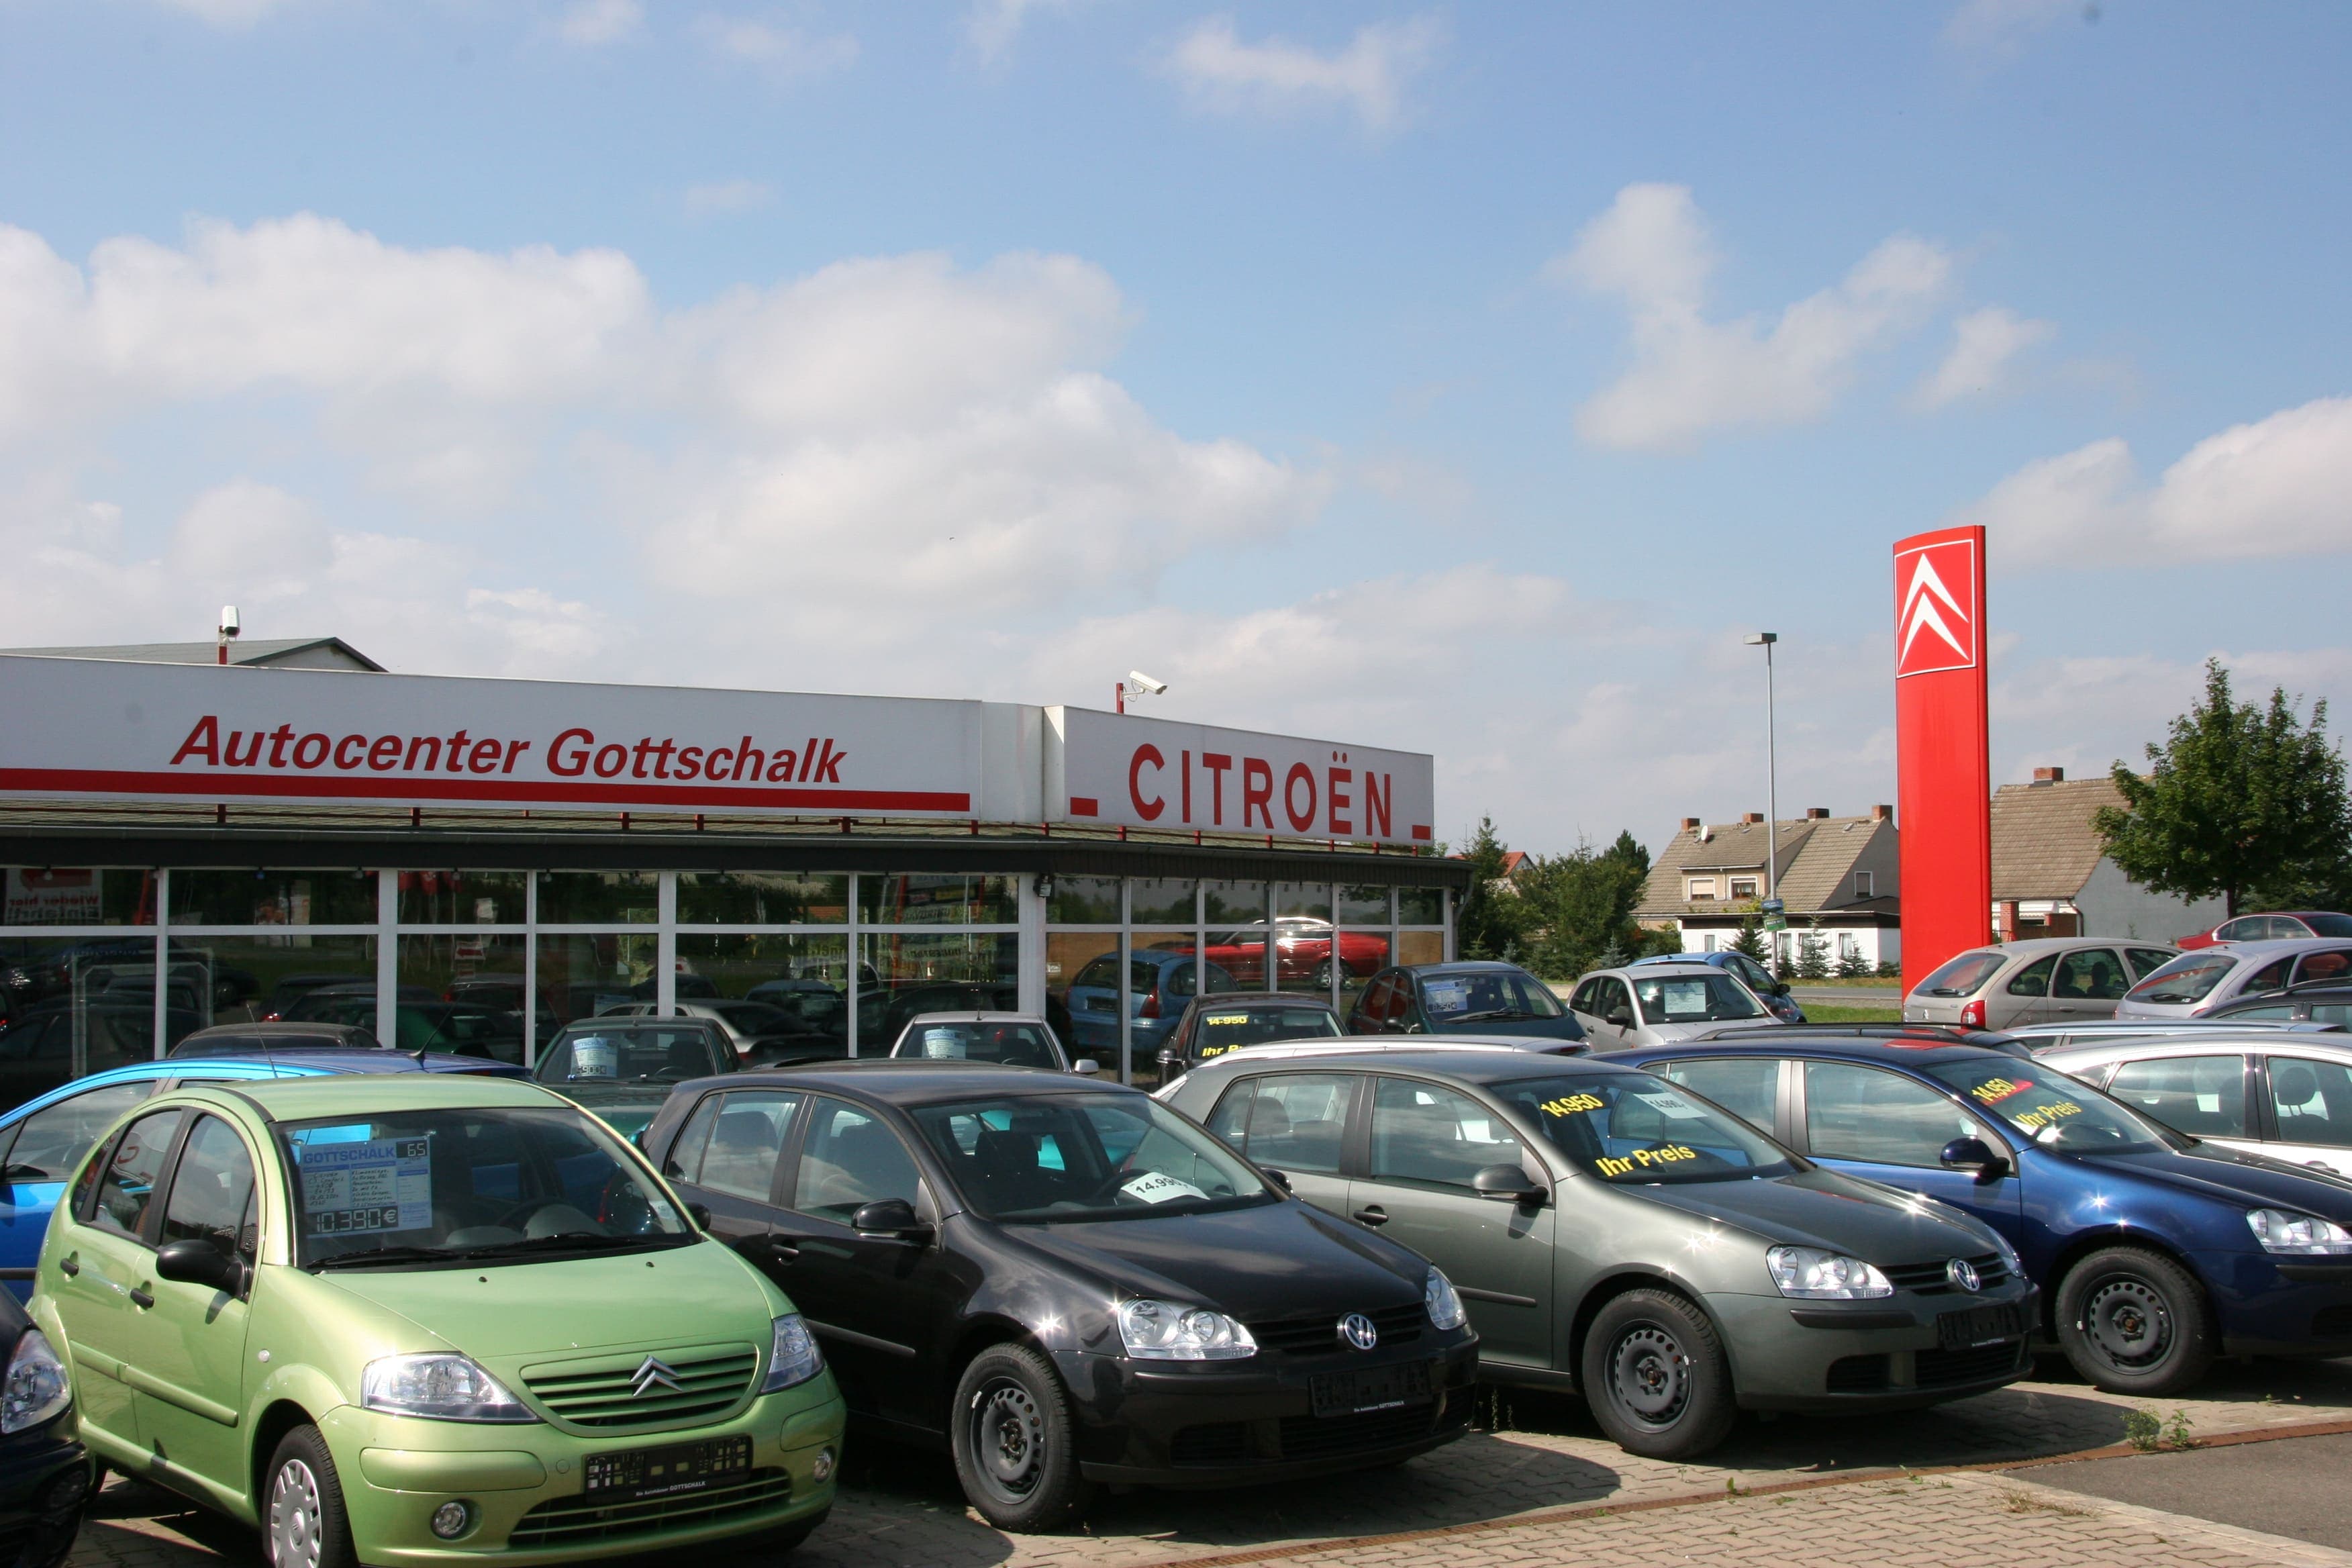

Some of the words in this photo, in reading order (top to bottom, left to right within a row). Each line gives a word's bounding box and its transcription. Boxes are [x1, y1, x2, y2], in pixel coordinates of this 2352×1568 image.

[170, 716, 529, 773] Autocenter
[547, 728, 846, 783] Gottschalk
[1129, 744, 1391, 836] CITROËN
[1202, 1047, 1224, 1057] Ihr
[1541, 1093, 1604, 1117] 14.950
[2016, 1112, 2047, 1128] Ihr
[2037, 1101, 2081, 1120] Preis
[304, 1146, 395, 1164] GOTTSCHALK
[407, 1142, 426, 1157] 65
[1596, 1157, 1634, 1176] Ihr
[1632, 1144, 1696, 1166] Preis
[669, 1481, 706, 1491] GOTTSCHALK
